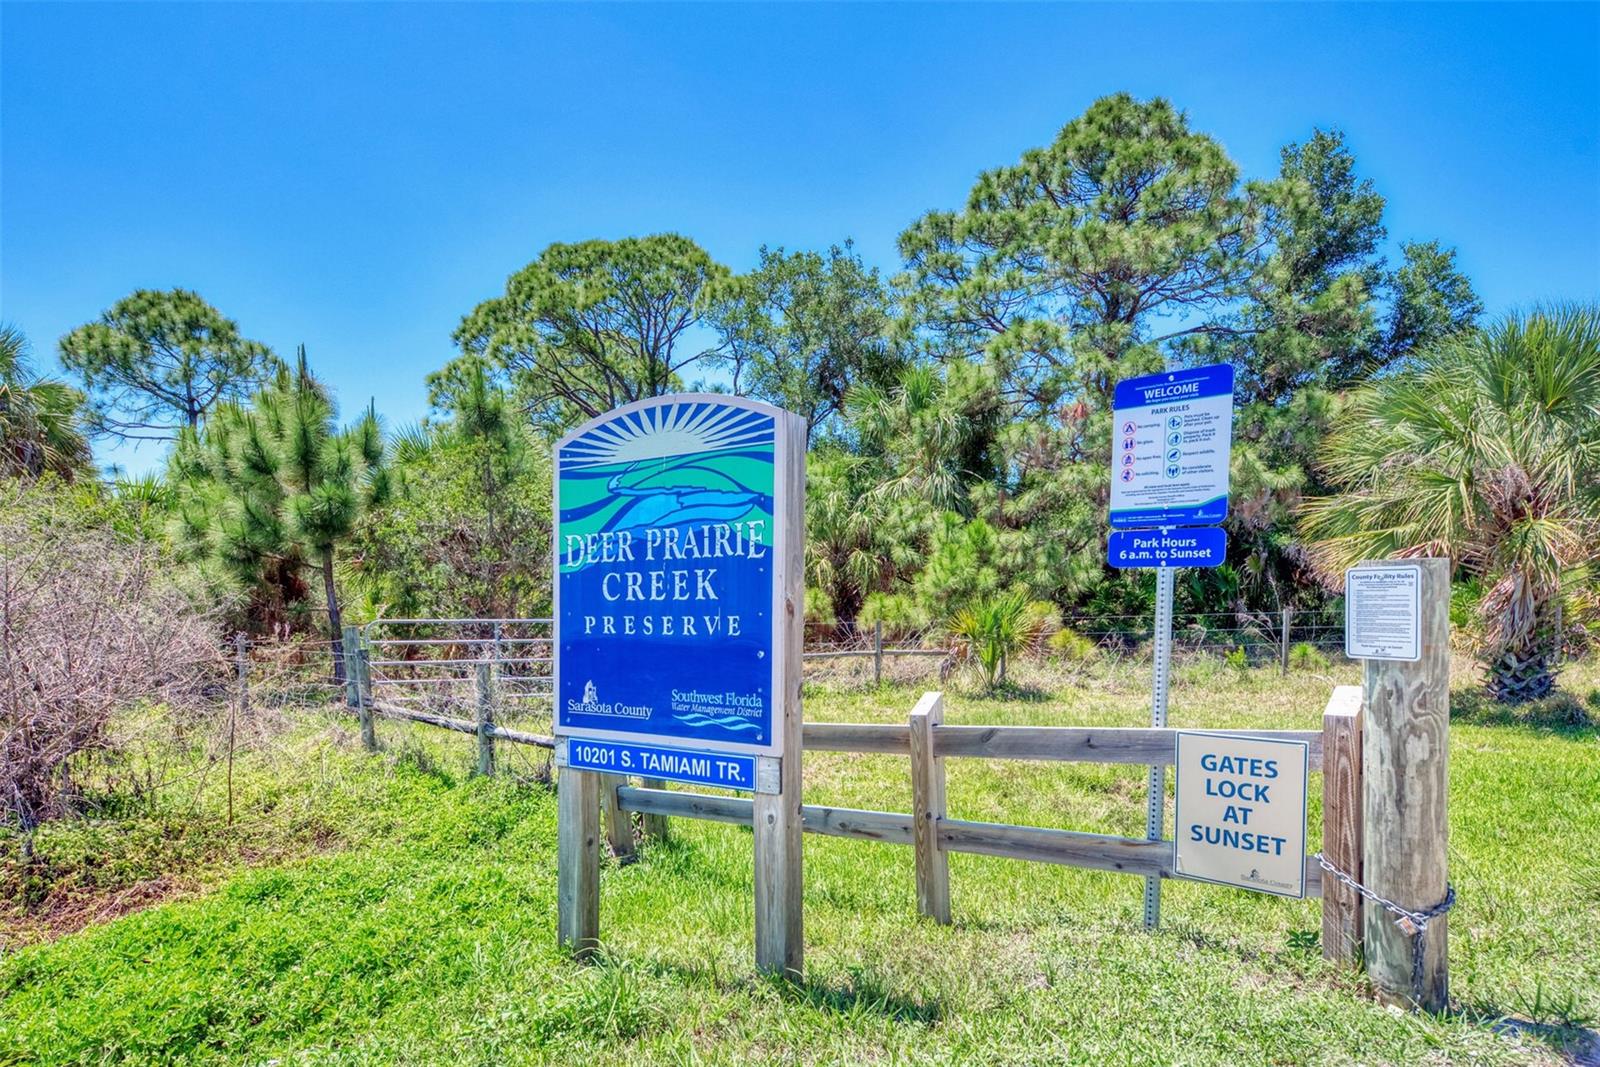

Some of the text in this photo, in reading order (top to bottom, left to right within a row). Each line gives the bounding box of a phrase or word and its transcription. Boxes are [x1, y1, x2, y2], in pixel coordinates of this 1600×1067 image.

[1144, 383, 1199, 399] WELCOME
[1169, 404, 1190, 412] RULES
[566, 520, 766, 568] DEER PRAIRIE
[1133, 538, 1197, 548] Park Hours
[1120, 550, 1127, 559] 6
[1155, 550, 1167, 558] to
[1170, 548, 1211, 558] Sunset
[602, 568, 719, 601] CREEK
[584, 615, 741, 636] PRESERVE
[672, 689, 762, 707] Southwest Florida
[568, 700, 652, 720] Sarasota County
[672, 702, 762, 718] Water Management District
[576, 746, 746, 782] 10201 S. TAMIAMI TR.
[1201, 754, 1278, 779] GATES
[1206, 778, 1270, 803] LOCK
[1223, 805, 1253, 825] AT
[1191, 824, 1286, 856] SUNSET
